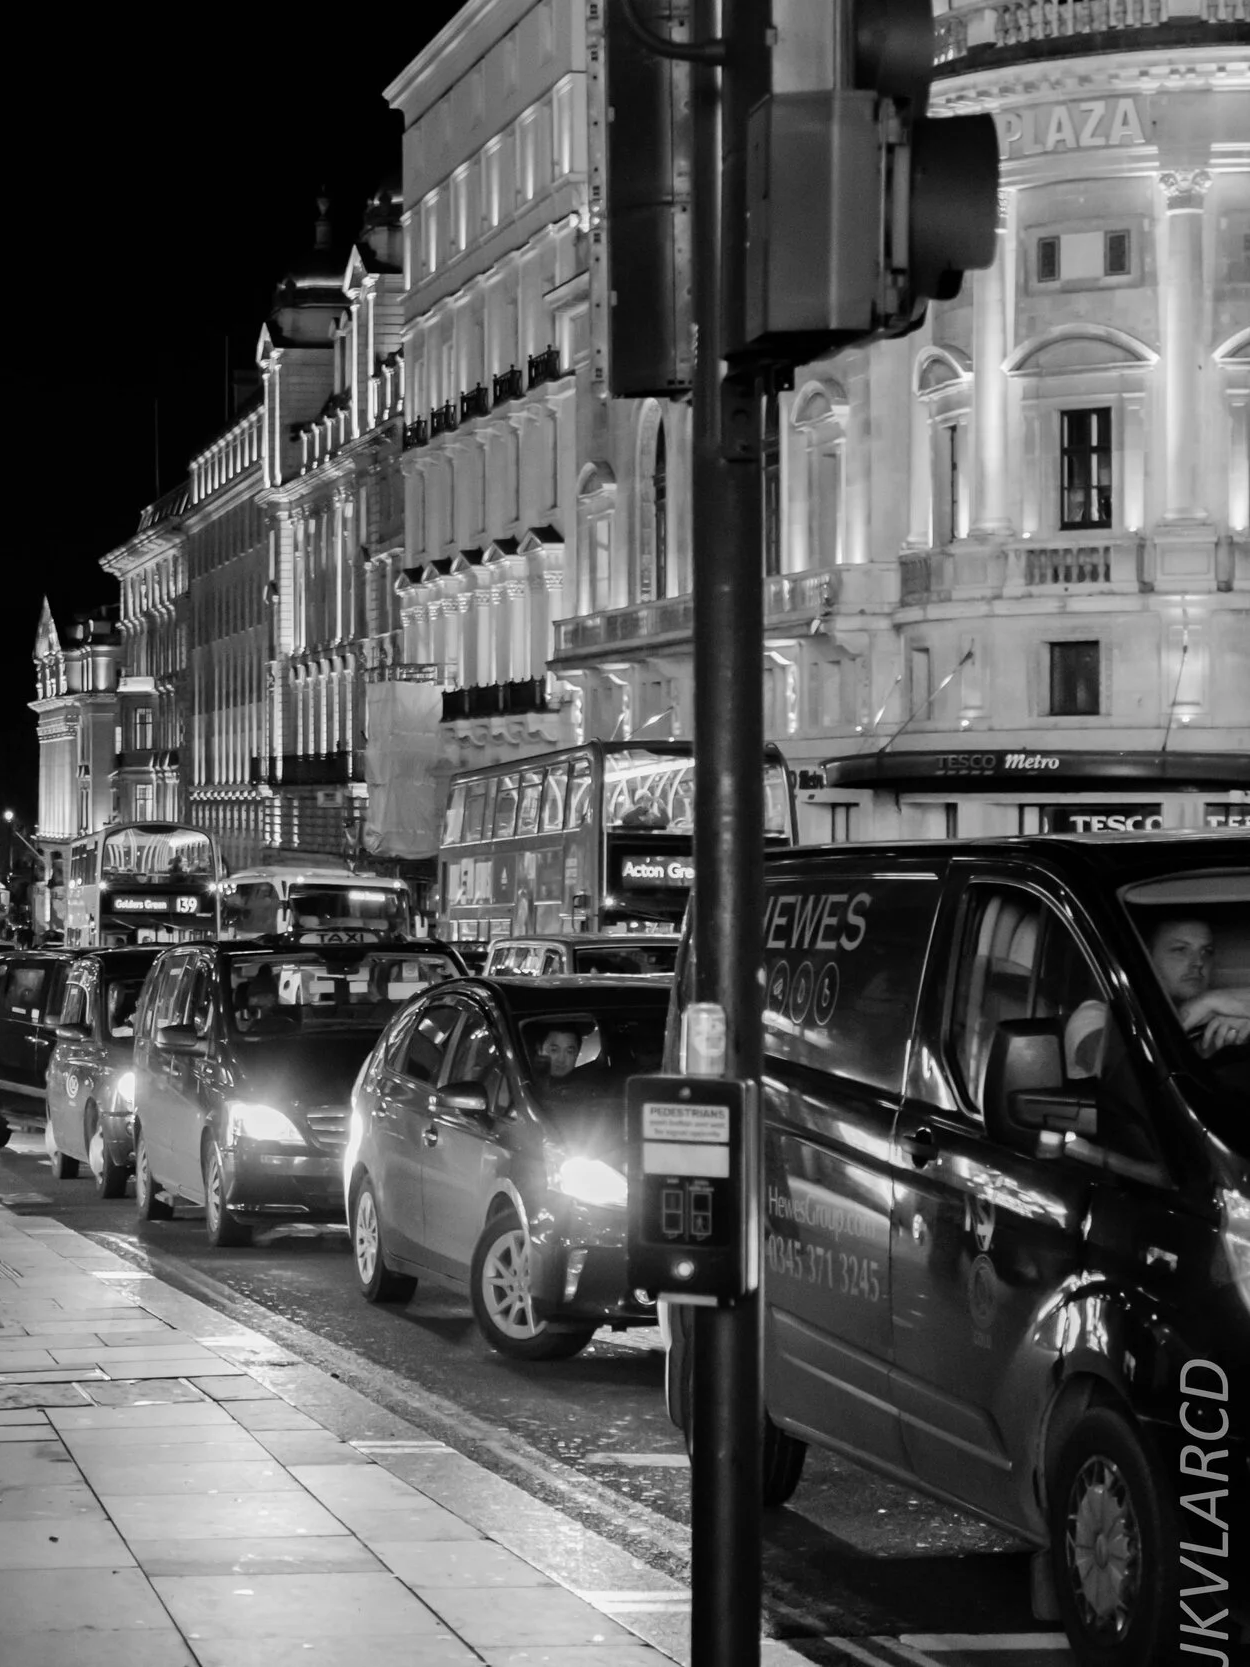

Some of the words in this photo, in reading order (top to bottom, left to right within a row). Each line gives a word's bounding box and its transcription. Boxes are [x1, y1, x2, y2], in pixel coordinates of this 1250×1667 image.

[996, 98, 1147, 160] PLAZA
[936, 754, 996, 769] TESCO
[1004, 753, 1060, 770] Metro
[622, 861, 665, 878] Acton
[114, 898, 144, 910] Golders
[144, 898, 168, 910] Green
[176, 896, 198, 913] 139
[316, 933, 365, 943] TAXI
[650, 1106, 726, 1120] PEDESTRIANS
[768, 1234, 803, 1280] 0345
[807, 1243, 834, 1289] 371
[839, 1252, 880, 1303] 3245
